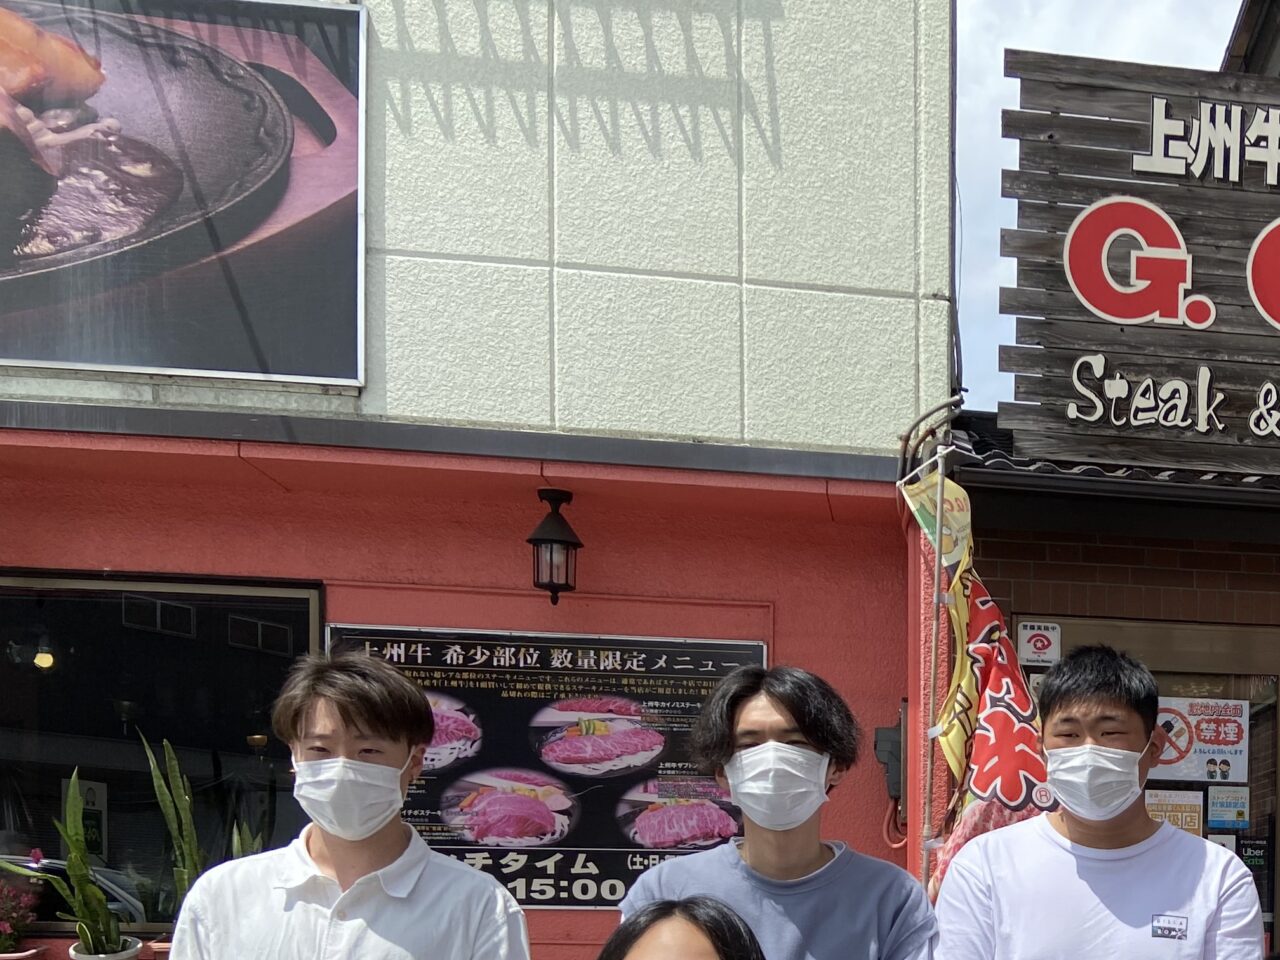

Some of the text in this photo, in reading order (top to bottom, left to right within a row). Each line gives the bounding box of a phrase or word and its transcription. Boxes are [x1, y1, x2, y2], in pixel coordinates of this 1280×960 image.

[1066, 354, 1226, 431] Steak
[441, 644, 541, 668] 希少部位
[1200, 722, 1239, 741] 禁煙
[1242, 847, 1264, 857] Uber
[507, 878, 625, 900] 15:00
